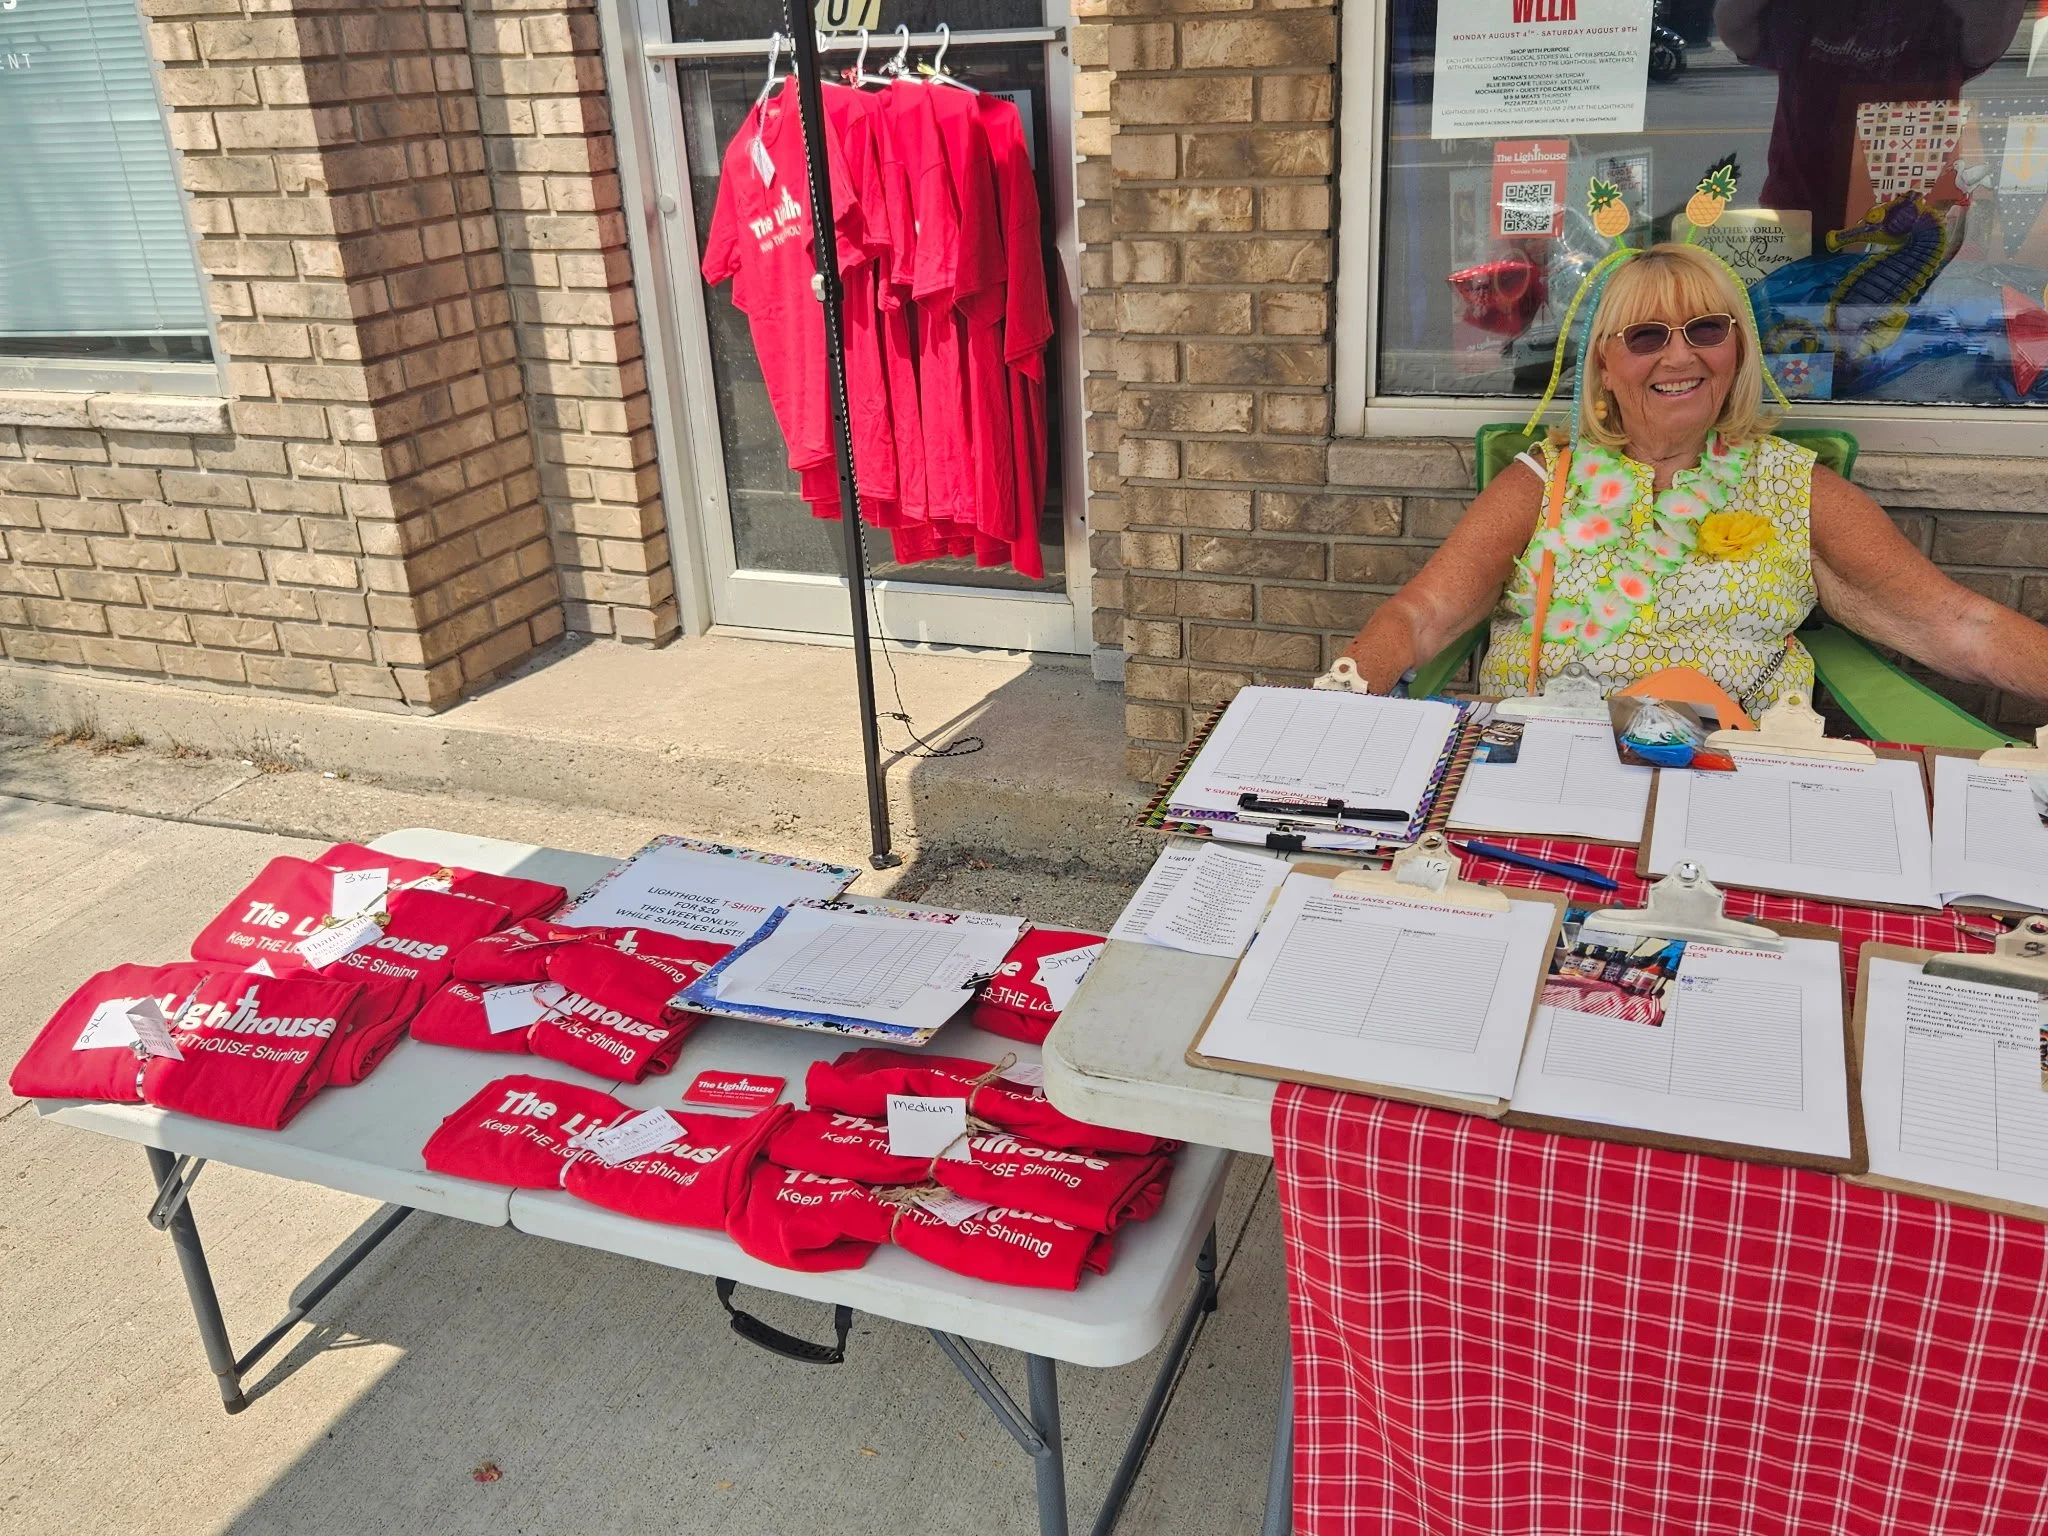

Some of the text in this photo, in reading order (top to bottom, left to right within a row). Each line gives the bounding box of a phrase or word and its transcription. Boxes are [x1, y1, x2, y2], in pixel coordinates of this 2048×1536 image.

[1452, 33, 1486, 41] MONDAY
[1541, 28, 1584, 37] SATURDAY
[1496, 144, 1567, 164] The Lighthouse
[1722, 226, 1744, 234] THE
[1726, 235, 1747, 244] MAY
[648, 886, 767, 914] LIGHTHOUSE T-SHIRT
[674, 901, 720, 915] FOR $20
[1332, 893, 1360, 902] BLUE
[1361, 896, 1385, 904] JAYS
[1386, 900, 1450, 913] COLLECTOR
[1451, 908, 1494, 918] BASKET
[242, 900, 290, 929] The
[616, 908, 746, 938] WHILE SUPPLIES LAST!!
[640, 904, 738, 928] THIS WEEK ONLY!!
[225, 930, 419, 980] Keep THE Shining
[1045, 949, 1096, 970] Small
[1689, 944, 1782, 960] CARD AND BBQ
[999, 986, 1029, 1008] THE
[1908, 979, 2014, 1000] Silent Auction Bid
[1906, 1017, 1945, 1027] Minimum
[1923, 1013, 1952, 1022] Market
[1934, 1029, 1964, 1038] Number
[252, 1045, 309, 1064] Shining
[586, 1026, 636, 1064] Shining
[698, 1080, 716, 1089] The
[717, 1078, 774, 1094] Lighthouse
[497, 1090, 558, 1120] The
[831, 1113, 889, 1133] The
[479, 1118, 517, 1137] Keep
[519, 1124, 554, 1147] THE
[649, 1160, 700, 1187] Shining
[868, 1138, 892, 1154] TH
[1021, 1162, 1082, 1188] Shining
[776, 1187, 1053, 1259] Keep THE Shining
